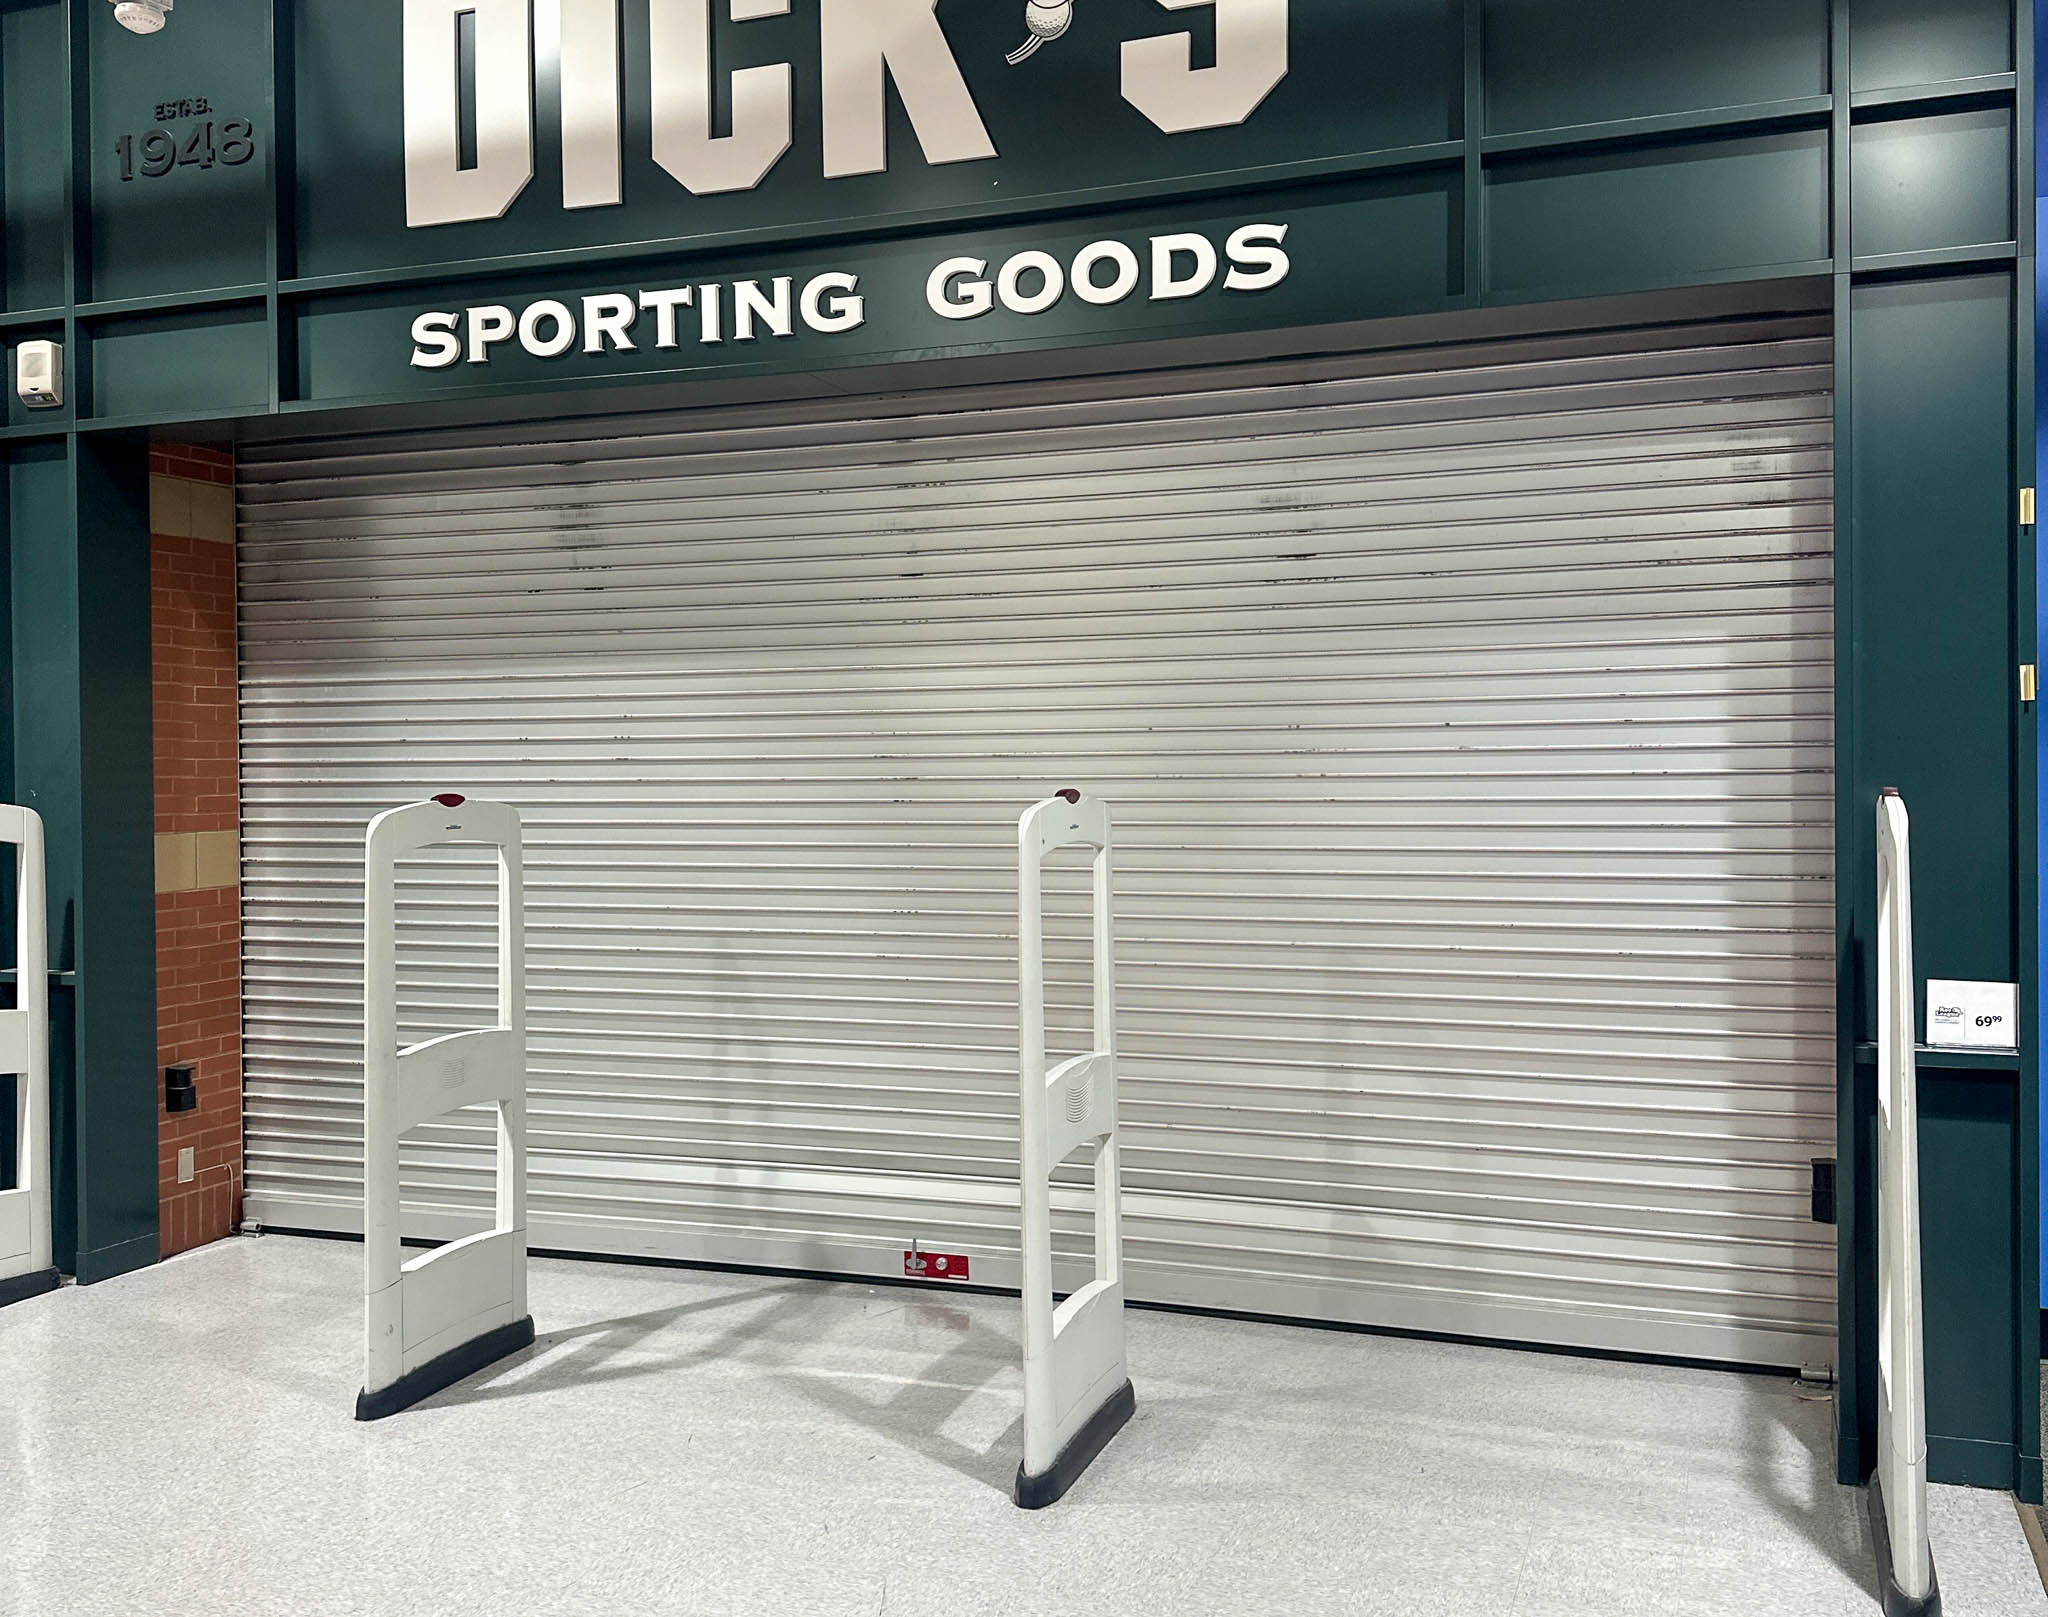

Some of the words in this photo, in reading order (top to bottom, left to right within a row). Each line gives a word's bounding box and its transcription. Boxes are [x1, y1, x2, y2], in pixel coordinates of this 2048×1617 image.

[154, 96, 213, 121] ESTAB.
[115, 116, 255, 182] 1948
[410, 271, 866, 368] SPORTING
[926, 223, 1290, 320] GOODS
